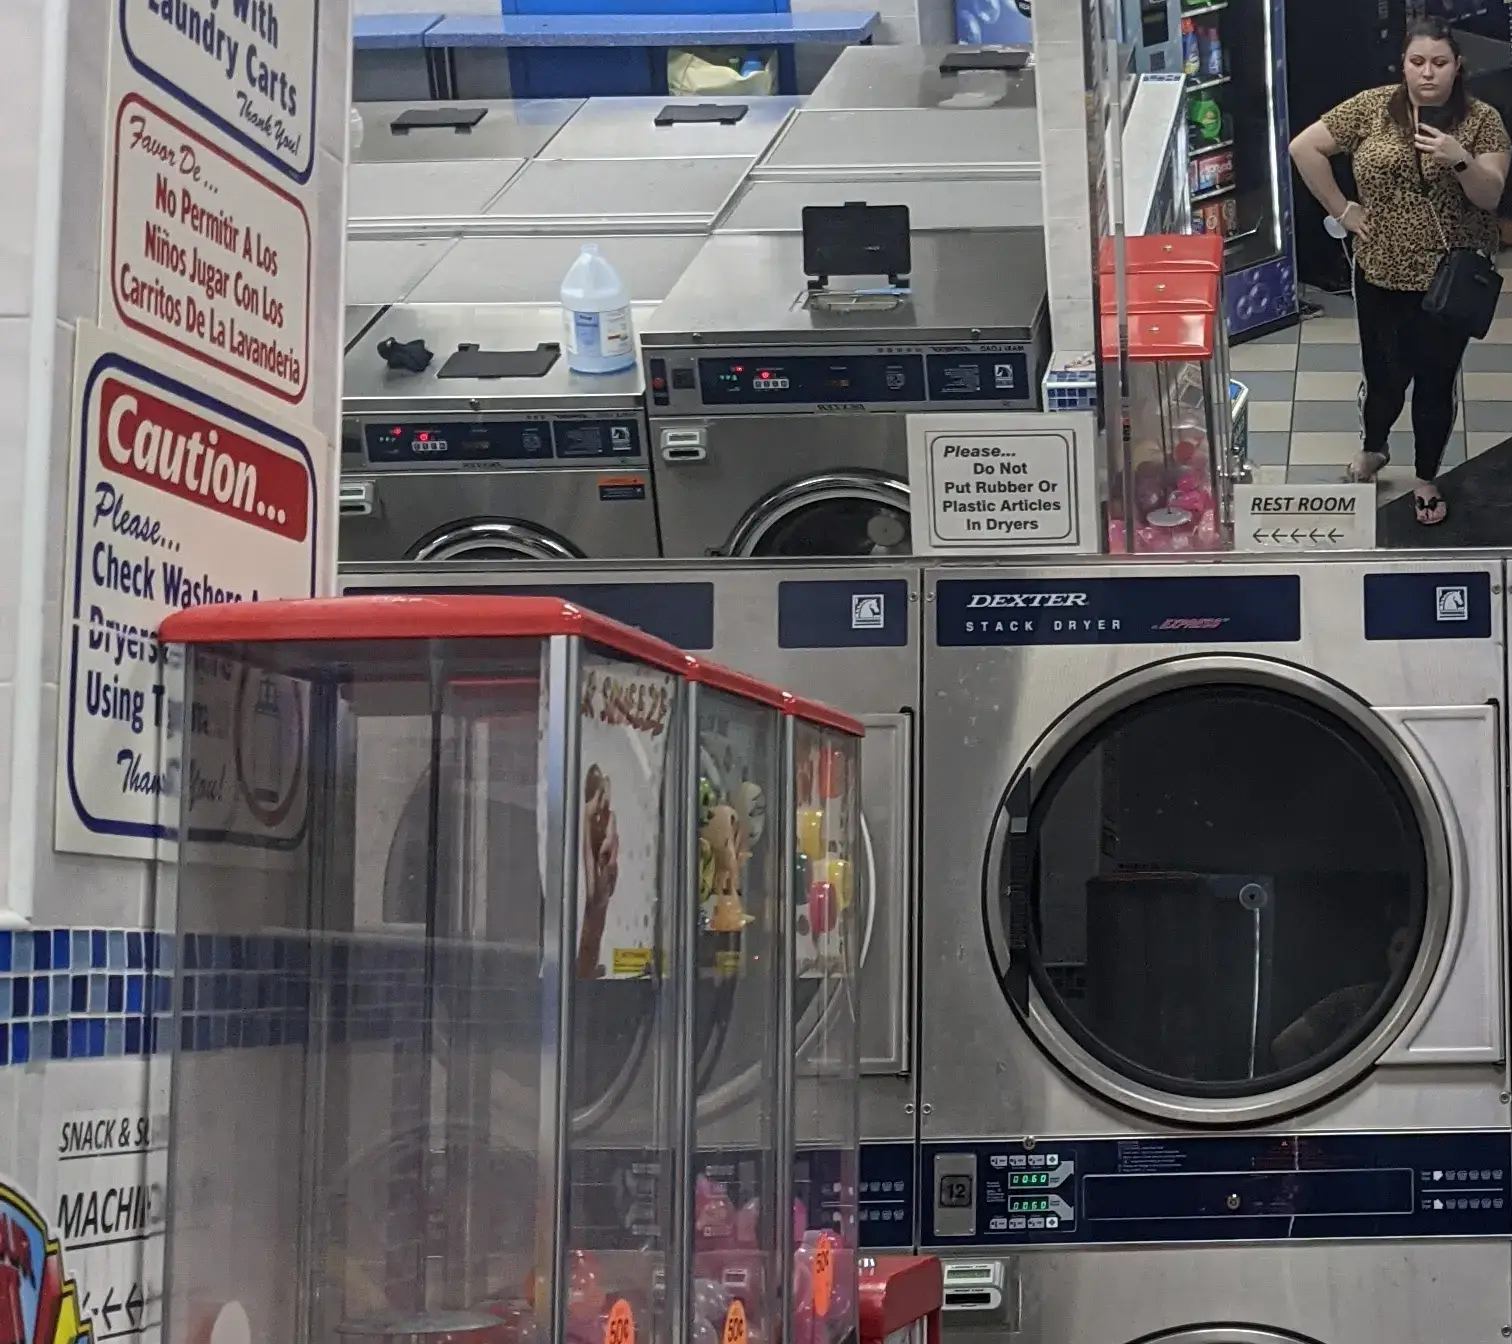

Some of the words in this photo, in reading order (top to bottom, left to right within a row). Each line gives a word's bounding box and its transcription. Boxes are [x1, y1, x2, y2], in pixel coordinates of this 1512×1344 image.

[245, 45, 298, 117] Carts
[129, 115, 177, 167] Favor
[237, 90, 273, 136] Thank
[274, 118, 301, 156] You!
[156, 173, 176, 218] No
[180, 188, 239, 252] Permitir
[242, 226, 253, 264] A
[256, 232, 278, 278] Los
[145, 220, 186, 278] Niños
[189, 247, 230, 300] Jugar
[234, 271, 259, 316] Con
[262, 286, 284, 329] Los
[120, 262, 182, 328] Carritos
[186, 295, 205, 340] De
[208, 307, 226, 347] La
[229, 322, 301, 385] Lavanderia
[106, 394, 287, 526] Caution...
[943, 445, 1016, 458] Please...
[973, 462, 995, 475] Do
[1000, 462, 1028, 475] Not
[944, 481, 971, 494] Put
[976, 480, 1033, 494] Rubber
[1038, 480, 1058, 493] Or
[1251, 497, 1294, 512] REST
[1298, 497, 1356, 512] ROOM
[92, 481, 182, 552] Please...
[942, 499, 996, 512] Plastic
[1000, 499, 1061, 512] Articles
[966, 519, 981, 531] In
[986, 518, 1039, 533] Dryers
[92, 541, 154, 601] Check
[162, 560, 242, 608] Wash
[966, 592, 1088, 609] DEXTER
[966, 620, 1035, 632] STACK
[1053, 619, 1122, 631] DRYER
[86, 670, 145, 735] Using
[59, 1119, 116, 1153] SNACK
[118, 1117, 131, 1147] &
[946, 1182, 966, 1199] 12
[727, 1317, 744, 1342] 50¢
